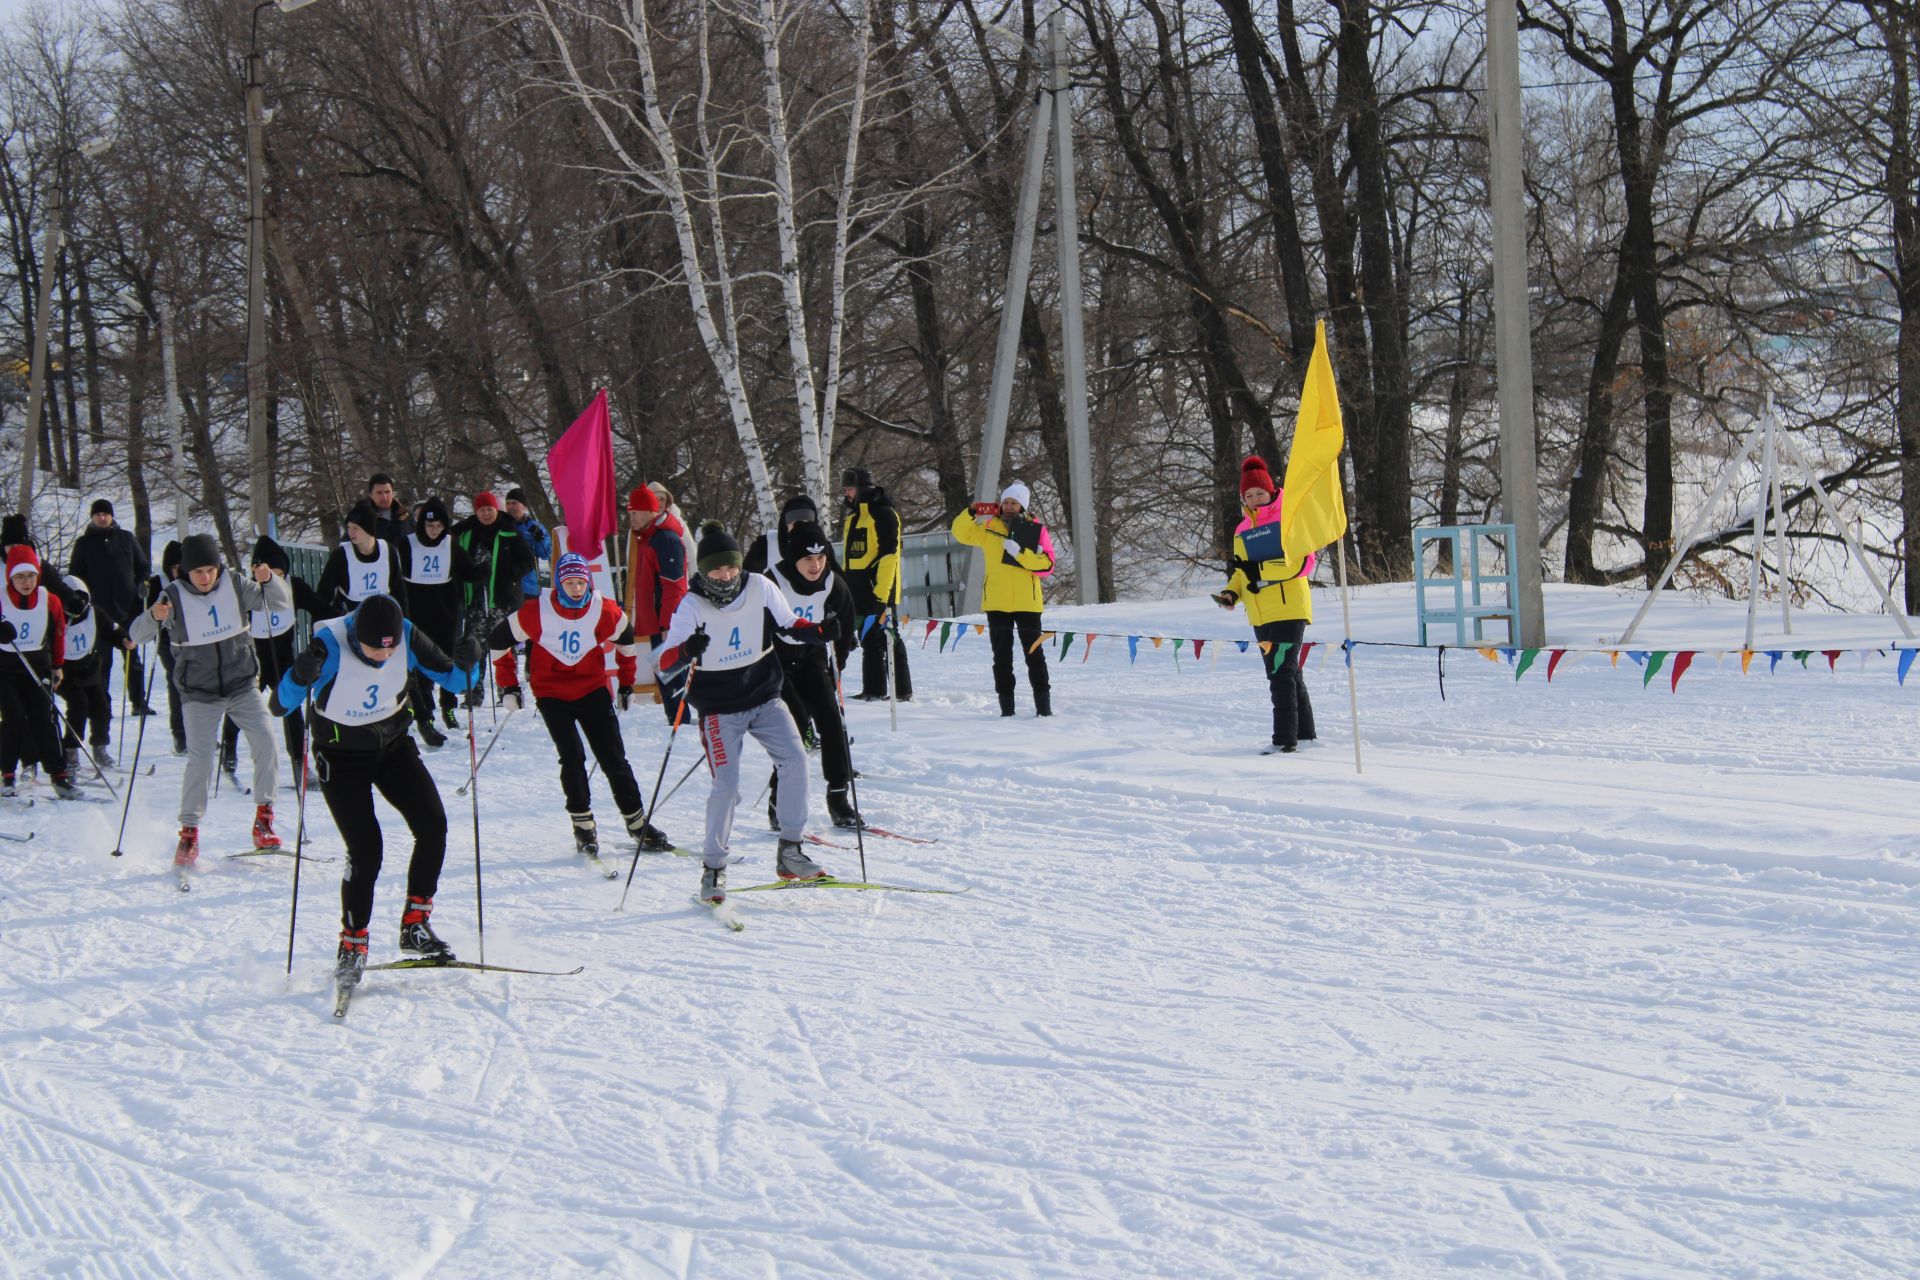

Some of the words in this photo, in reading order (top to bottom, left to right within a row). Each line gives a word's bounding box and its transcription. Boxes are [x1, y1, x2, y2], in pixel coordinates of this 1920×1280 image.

[423, 555, 440, 572] 24
[362, 572, 378, 590] 12
[208, 605, 219, 627] 1
[270, 611, 280, 626] 6
[20, 622, 30, 639] 8
[728, 626, 741, 650] 4
[72, 633, 87, 651] 11
[558, 630, 580, 654] 16
[362, 684, 379, 709] 3
